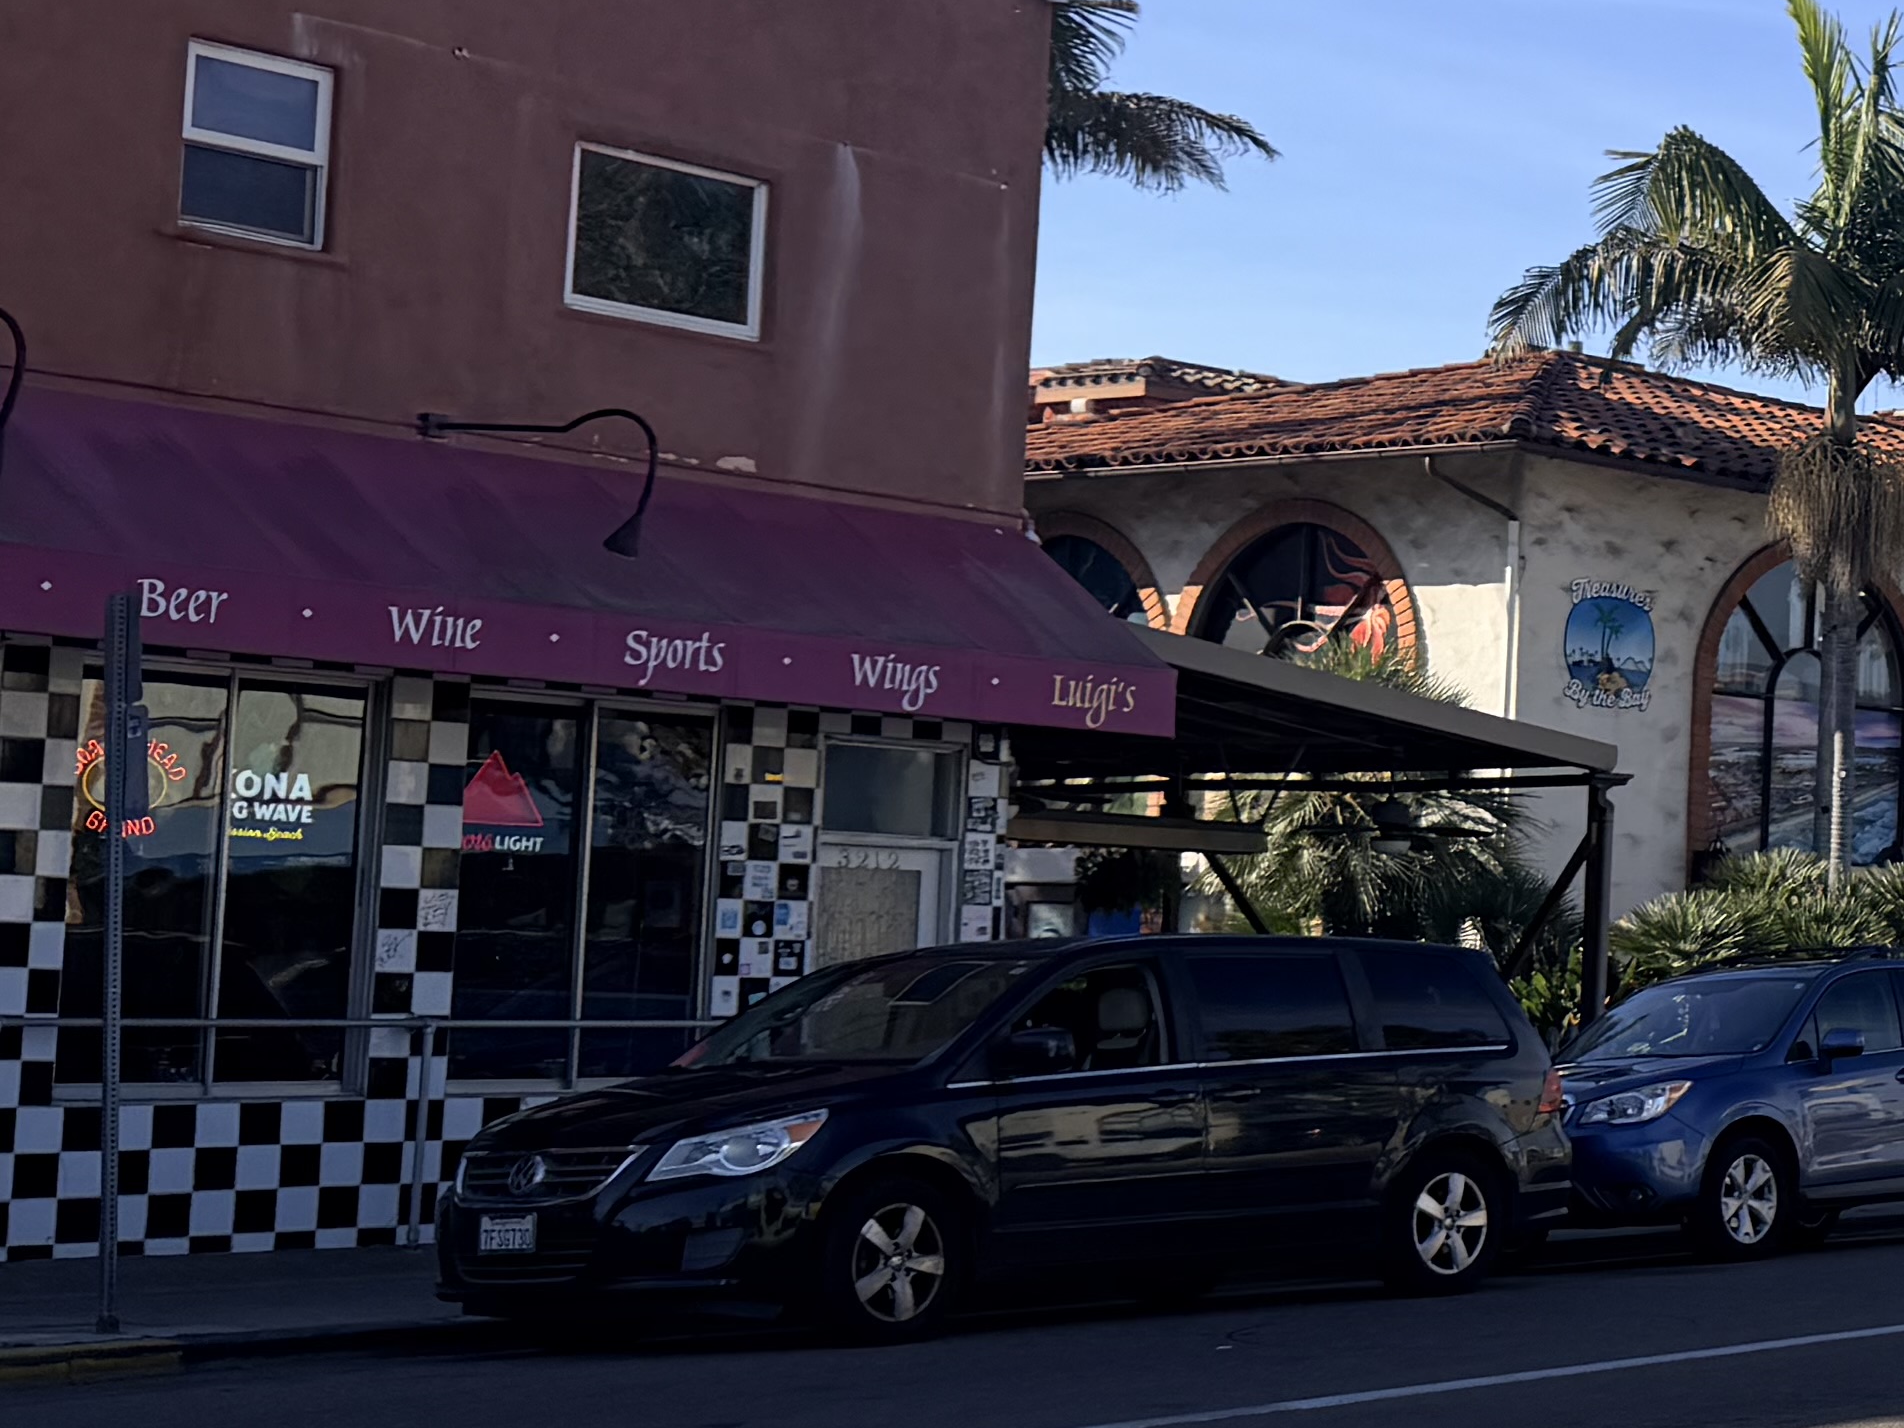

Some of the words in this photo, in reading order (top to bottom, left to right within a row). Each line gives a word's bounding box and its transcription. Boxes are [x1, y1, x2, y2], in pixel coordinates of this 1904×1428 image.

[137, 578, 228, 623] Beer
[1571, 577, 1654, 612] Treasures
[388, 605, 483, 650] Wine
[623, 629, 726, 686] Sports
[850, 652, 941, 712] Wings
[1563, 678, 1590, 708] By
[1591, 687, 1617, 708] the
[1618, 686, 1652, 712] Bay
[1051, 674, 1137, 729] Luigi's
[232, 768, 313, 801] ONA
[253, 801, 314, 823] WAVE
[494, 835, 544, 852] LIGHT
[837, 847, 901, 869] 3212
